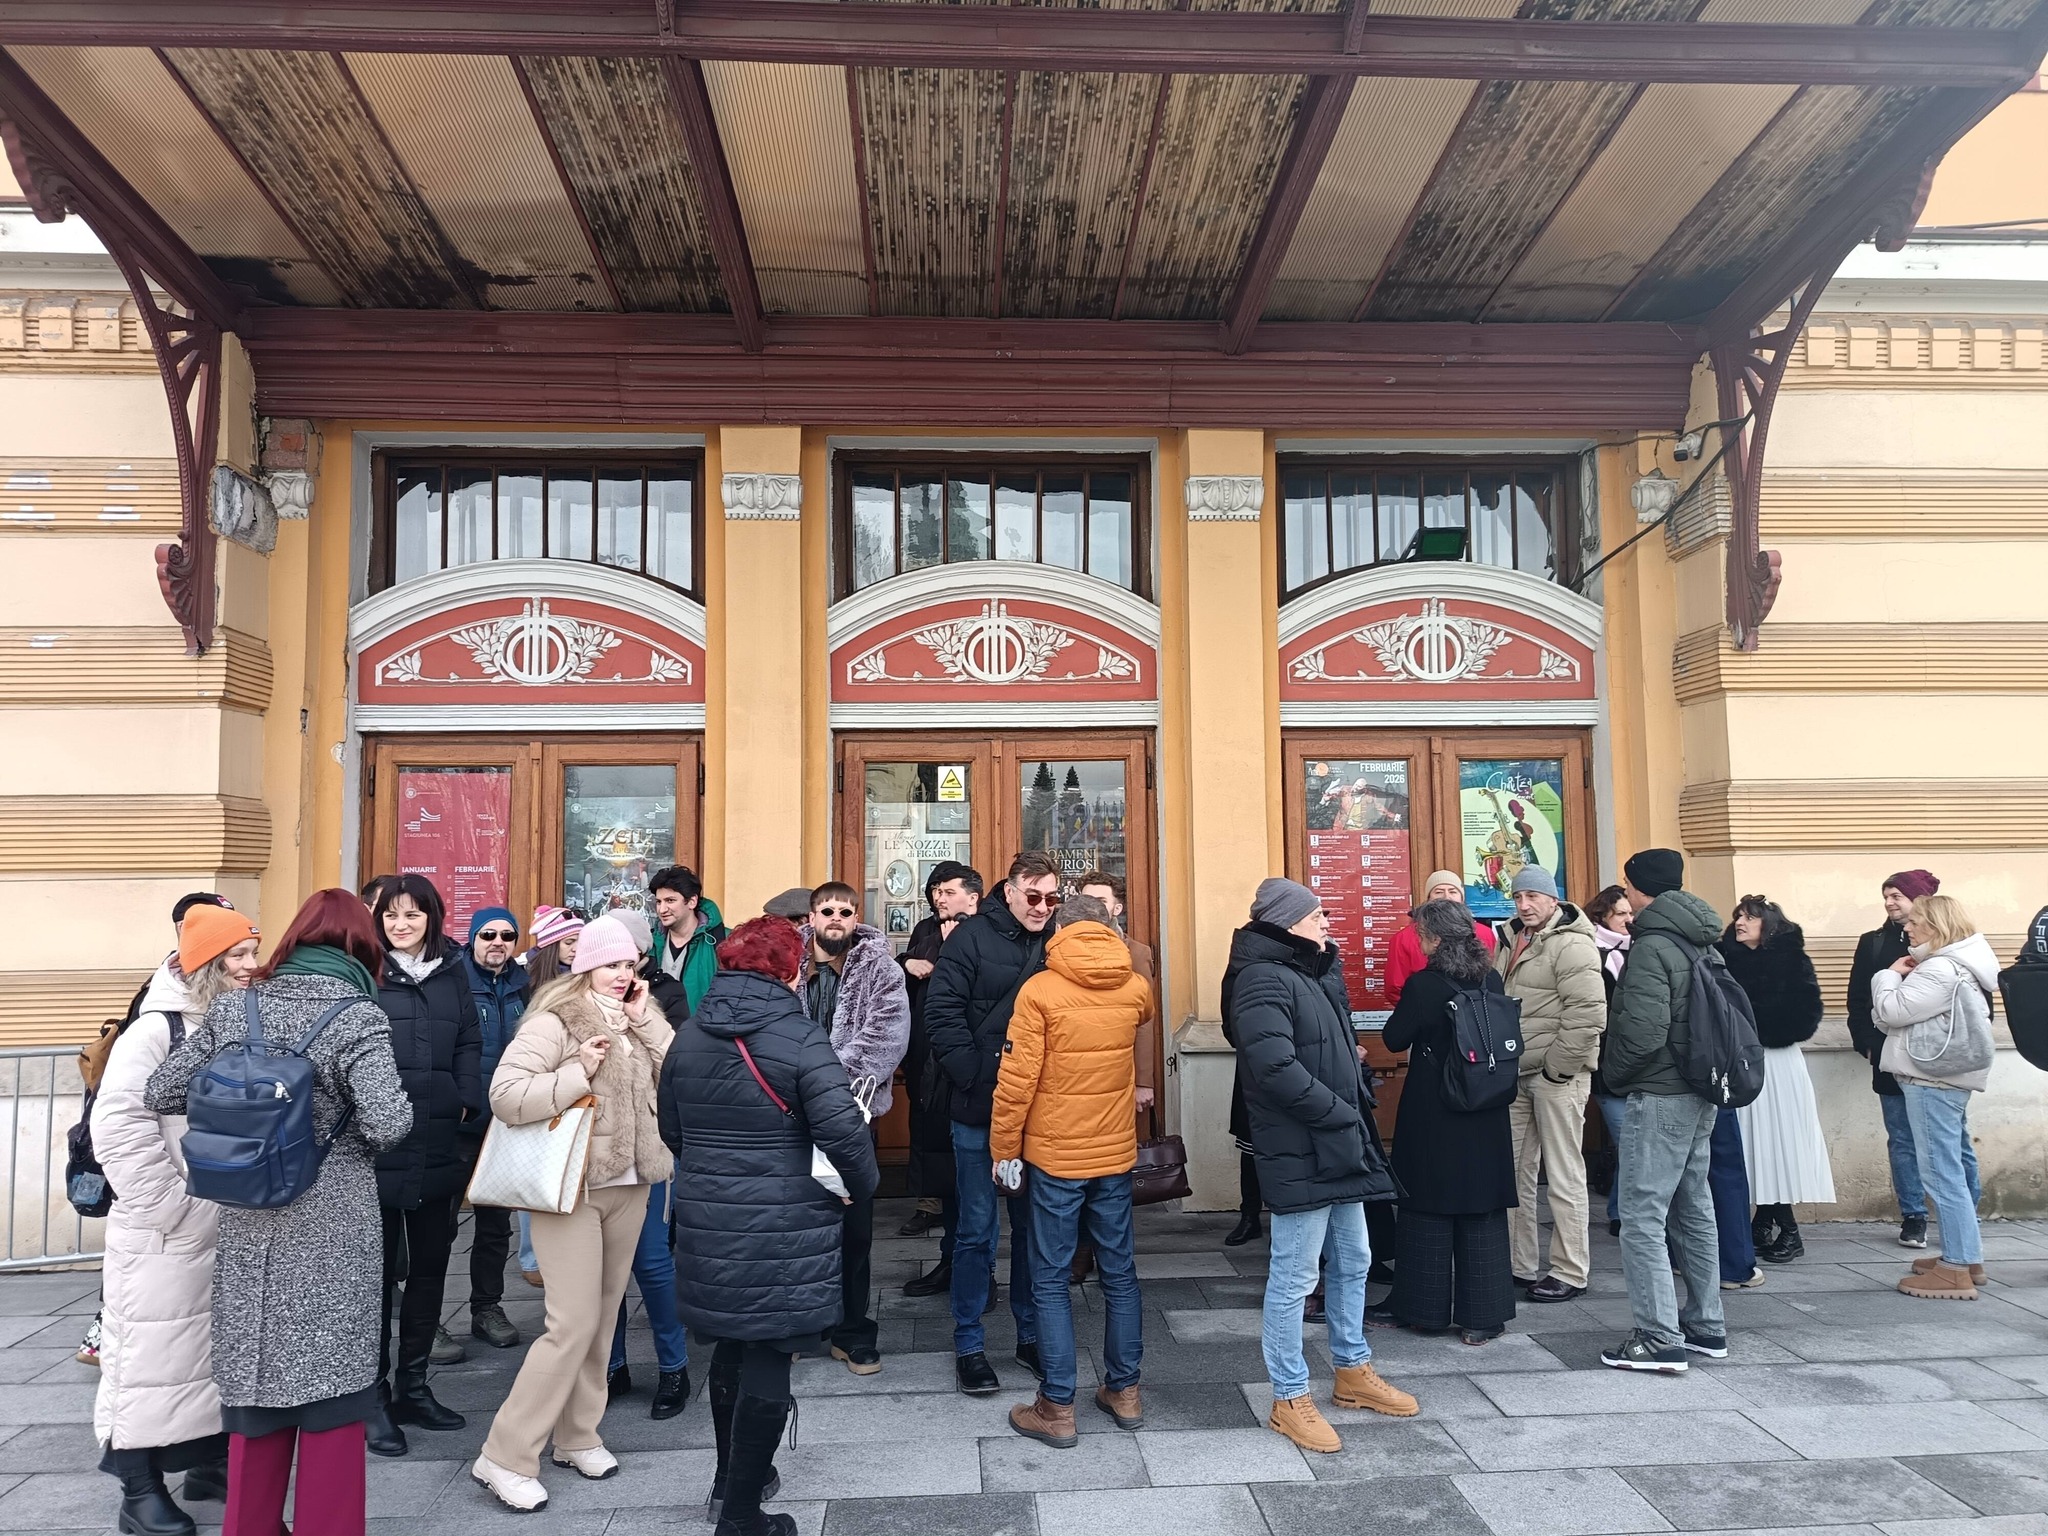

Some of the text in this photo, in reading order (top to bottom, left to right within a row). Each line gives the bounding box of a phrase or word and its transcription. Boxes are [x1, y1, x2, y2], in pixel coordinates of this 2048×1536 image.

[1360, 763, 1405, 772] FEBRUARIE
[1384, 774, 1405, 784] 2026
[1042, 801, 1098, 849] 12
[884, 840, 951, 850] LE NOZZE
[907, 850, 951, 858] di FIGARO
[1047, 849, 1097, 860] OAMENI
[454, 865, 495, 873] FEBRUARIE
